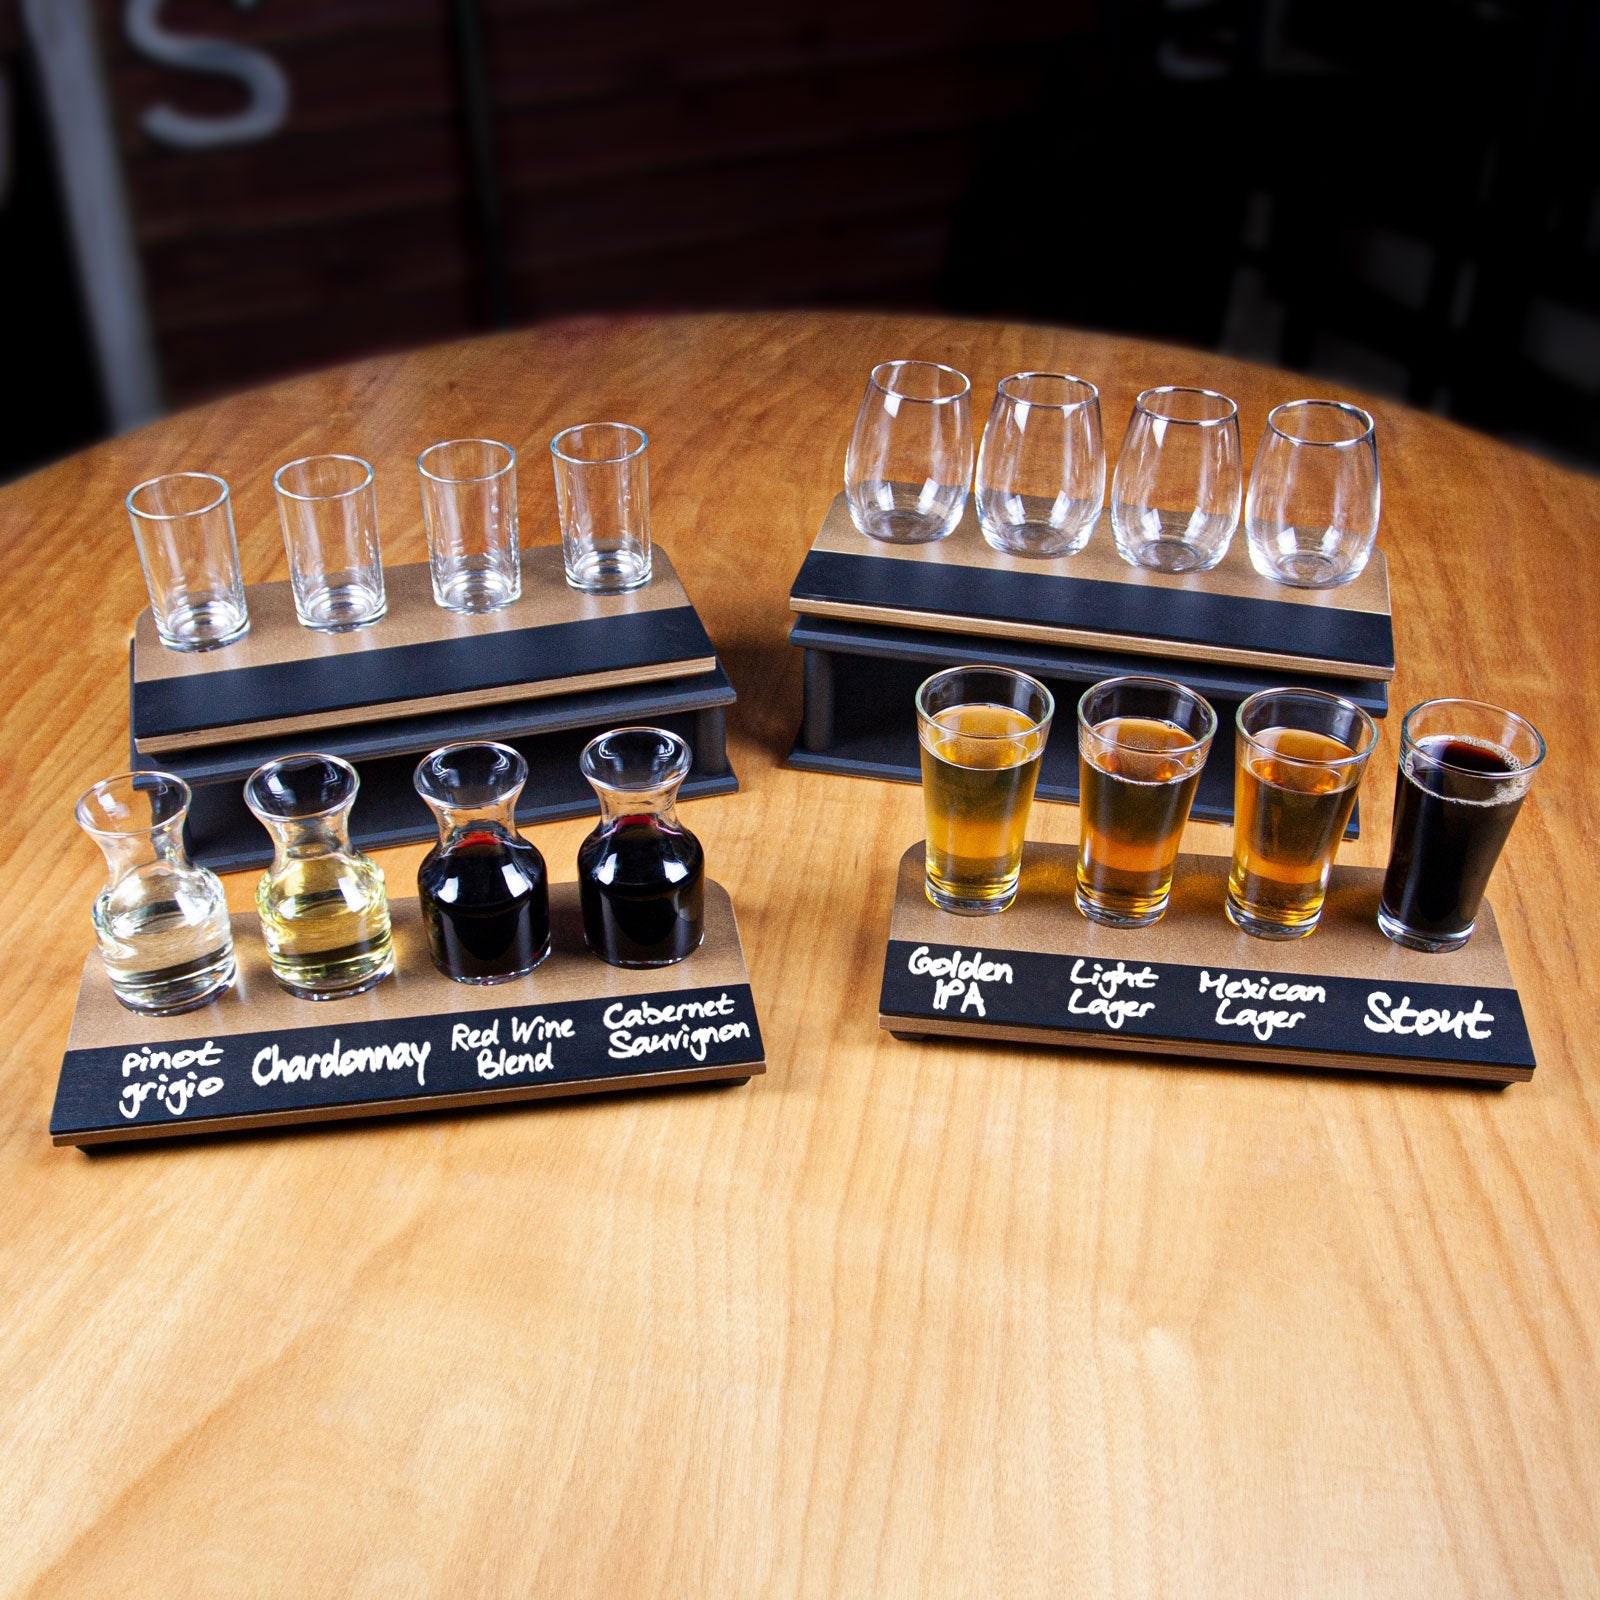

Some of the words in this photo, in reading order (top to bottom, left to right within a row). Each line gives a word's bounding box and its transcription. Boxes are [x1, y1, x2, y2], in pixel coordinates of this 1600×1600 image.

[907, 945, 1014, 986] Golden
[1069, 958, 1160, 999] Light
[932, 978, 987, 1017] IPA
[1198, 970, 1326, 1004] Mexican
[602, 992, 736, 1031] Cabernet
[1067, 988, 1156, 1030] Lager
[1214, 997, 1307, 1041] Lager
[1363, 990, 1496, 1040] Stout
[451, 1018, 500, 1052] Red
[510, 1015, 576, 1046] Wine
[606, 1021, 751, 1062] Sauvignon
[121, 1039, 225, 1078] pinot
[251, 1038, 432, 1087] Chardonnay
[476, 1041, 555, 1080] Blend
[118, 1071, 225, 1120] grigio
